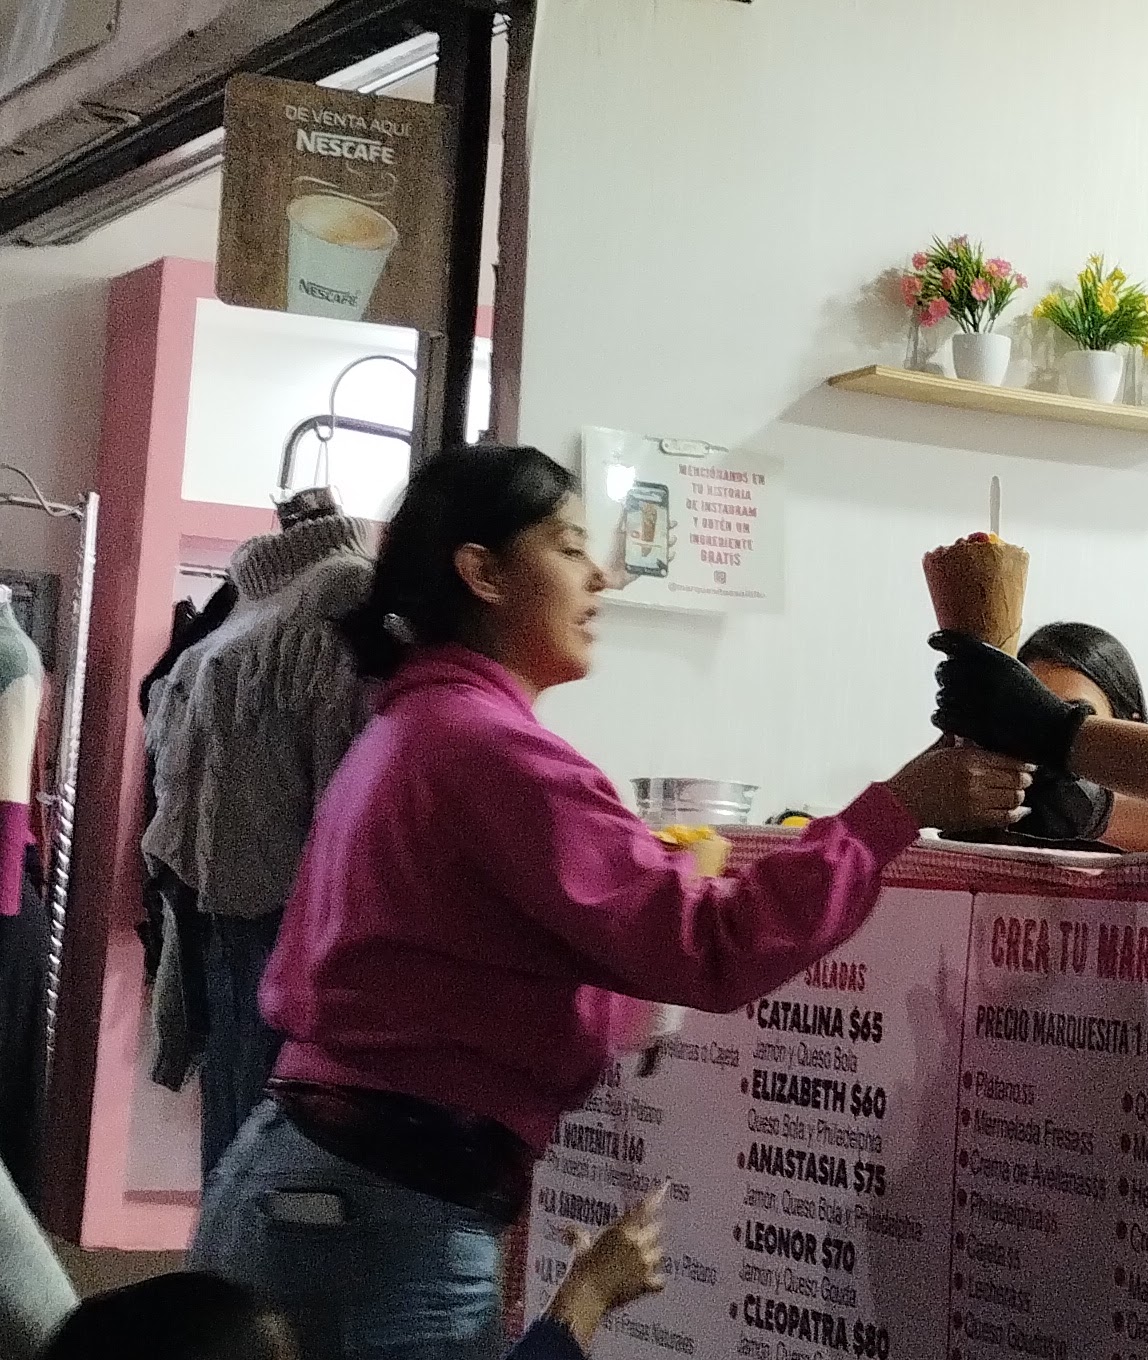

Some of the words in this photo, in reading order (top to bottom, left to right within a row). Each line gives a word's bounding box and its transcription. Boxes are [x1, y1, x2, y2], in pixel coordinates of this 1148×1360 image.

[285, 105, 309, 122] DE
[311, 107, 367, 128] VENTA
[692, 482, 703, 495] TU
[707, 486, 752, 500] HISTORIA
[685, 498, 698, 511] DE
[701, 500, 757, 517] INSTAGRAM
[690, 532, 753, 550] INGREDIENTE
[700, 549, 741, 566] GRATIS
[991, 915, 1049, 975] CREA
[1059, 921, 1088, 976] TU
[804, 960, 867, 991] SALADAS
[757, 999, 843, 1038] CATALINA
[849, 1006, 883, 1043] $65
[976, 1005, 1029, 1042] PRECIO
[1033, 1011, 1129, 1055] MARQUESITA
[798, 1042, 831, 1069] Queso
[834, 1046, 857, 1073] Bola
[752, 1069, 846, 1113] ELIZABETH
[850, 1080, 886, 1120] $60
[748, 1107, 780, 1136] Queso
[783, 1114, 805, 1140] Bola
[747, 1142, 848, 1189] ANASTASIA
[853, 1157, 887, 1197] $75
[782, 1189, 816, 1220] Queso
[745, 1220, 817, 1266] LEONOR
[821, 1232, 857, 1276] $70
[743, 1294, 848, 1352] CLEOPATRA
